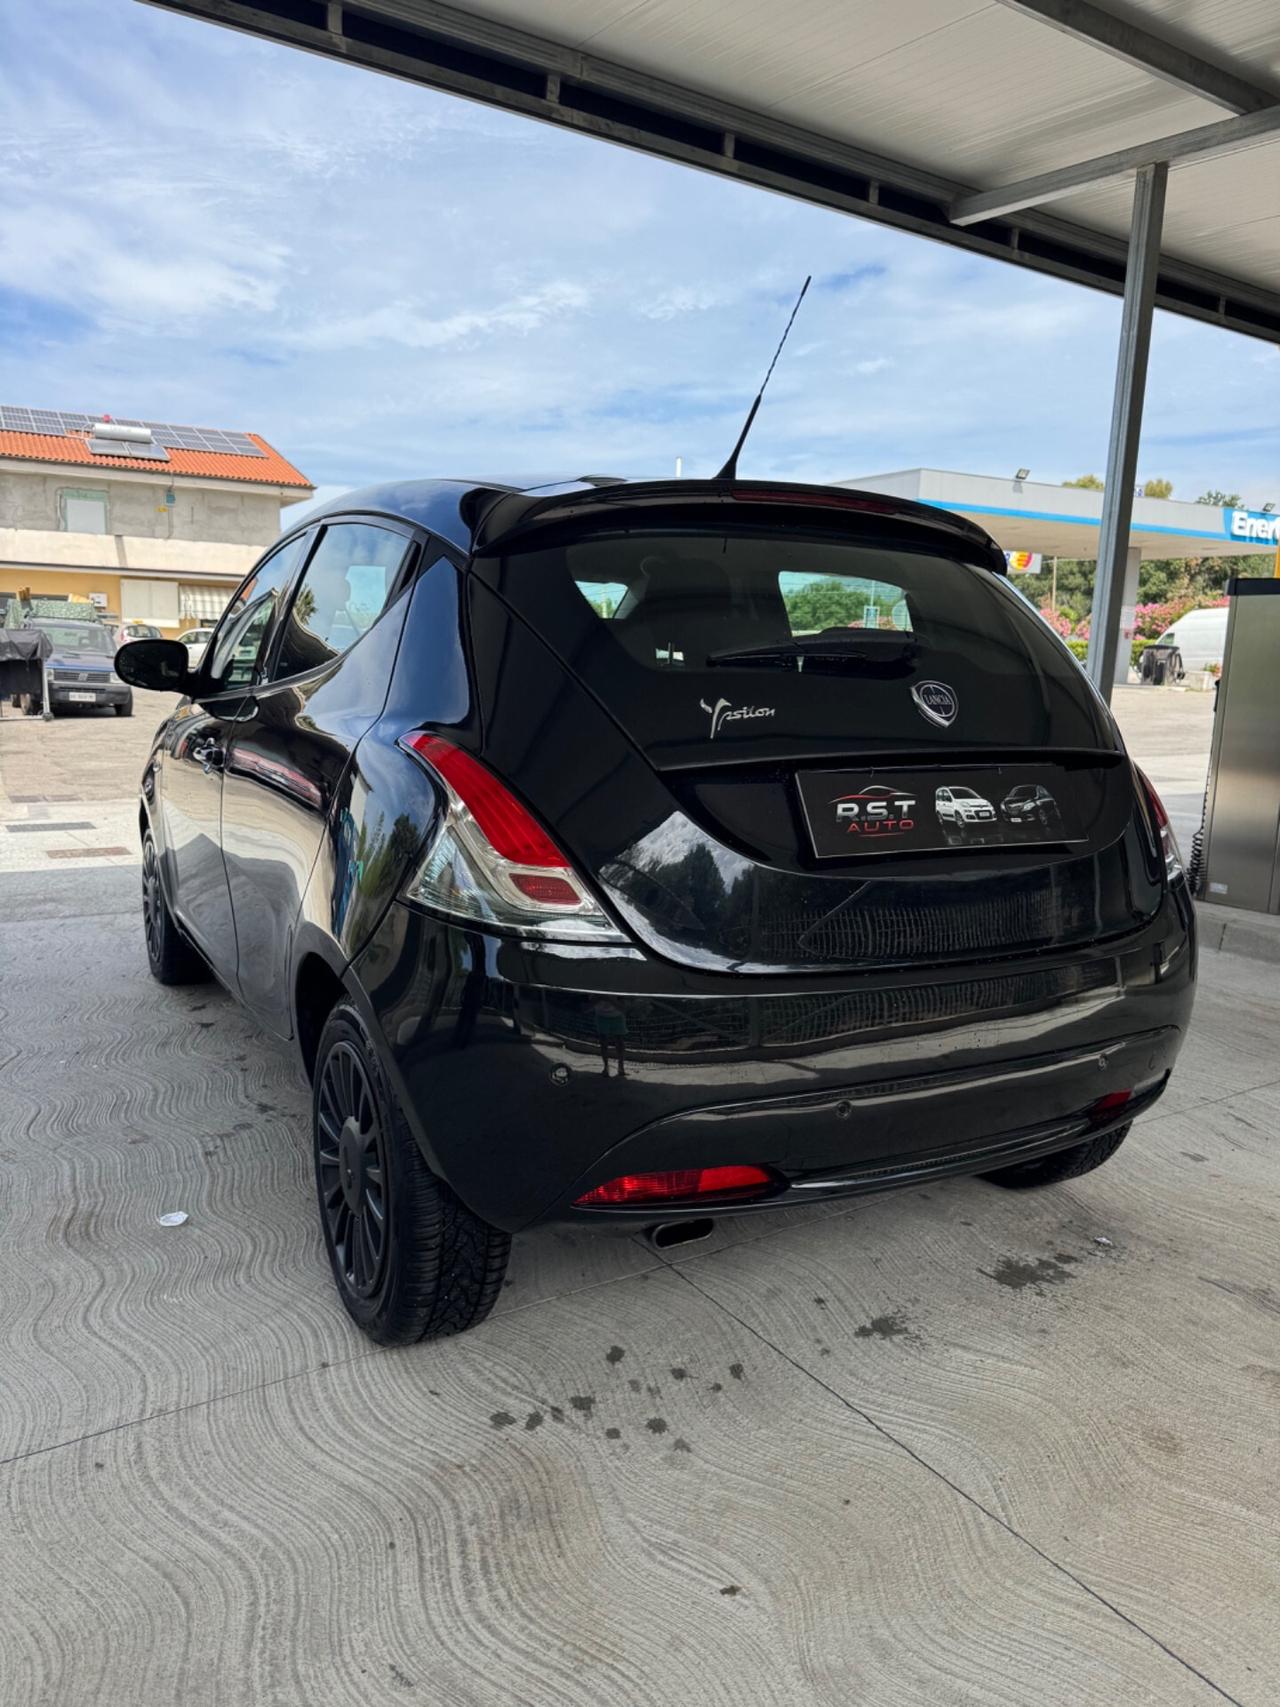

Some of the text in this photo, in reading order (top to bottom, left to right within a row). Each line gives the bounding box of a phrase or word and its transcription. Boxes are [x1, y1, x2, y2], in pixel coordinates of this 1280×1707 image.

[1232, 510, 1280, 540] Ener
[700, 698, 775, 739] Ypsilon
[847, 819, 914, 832] AUTO
